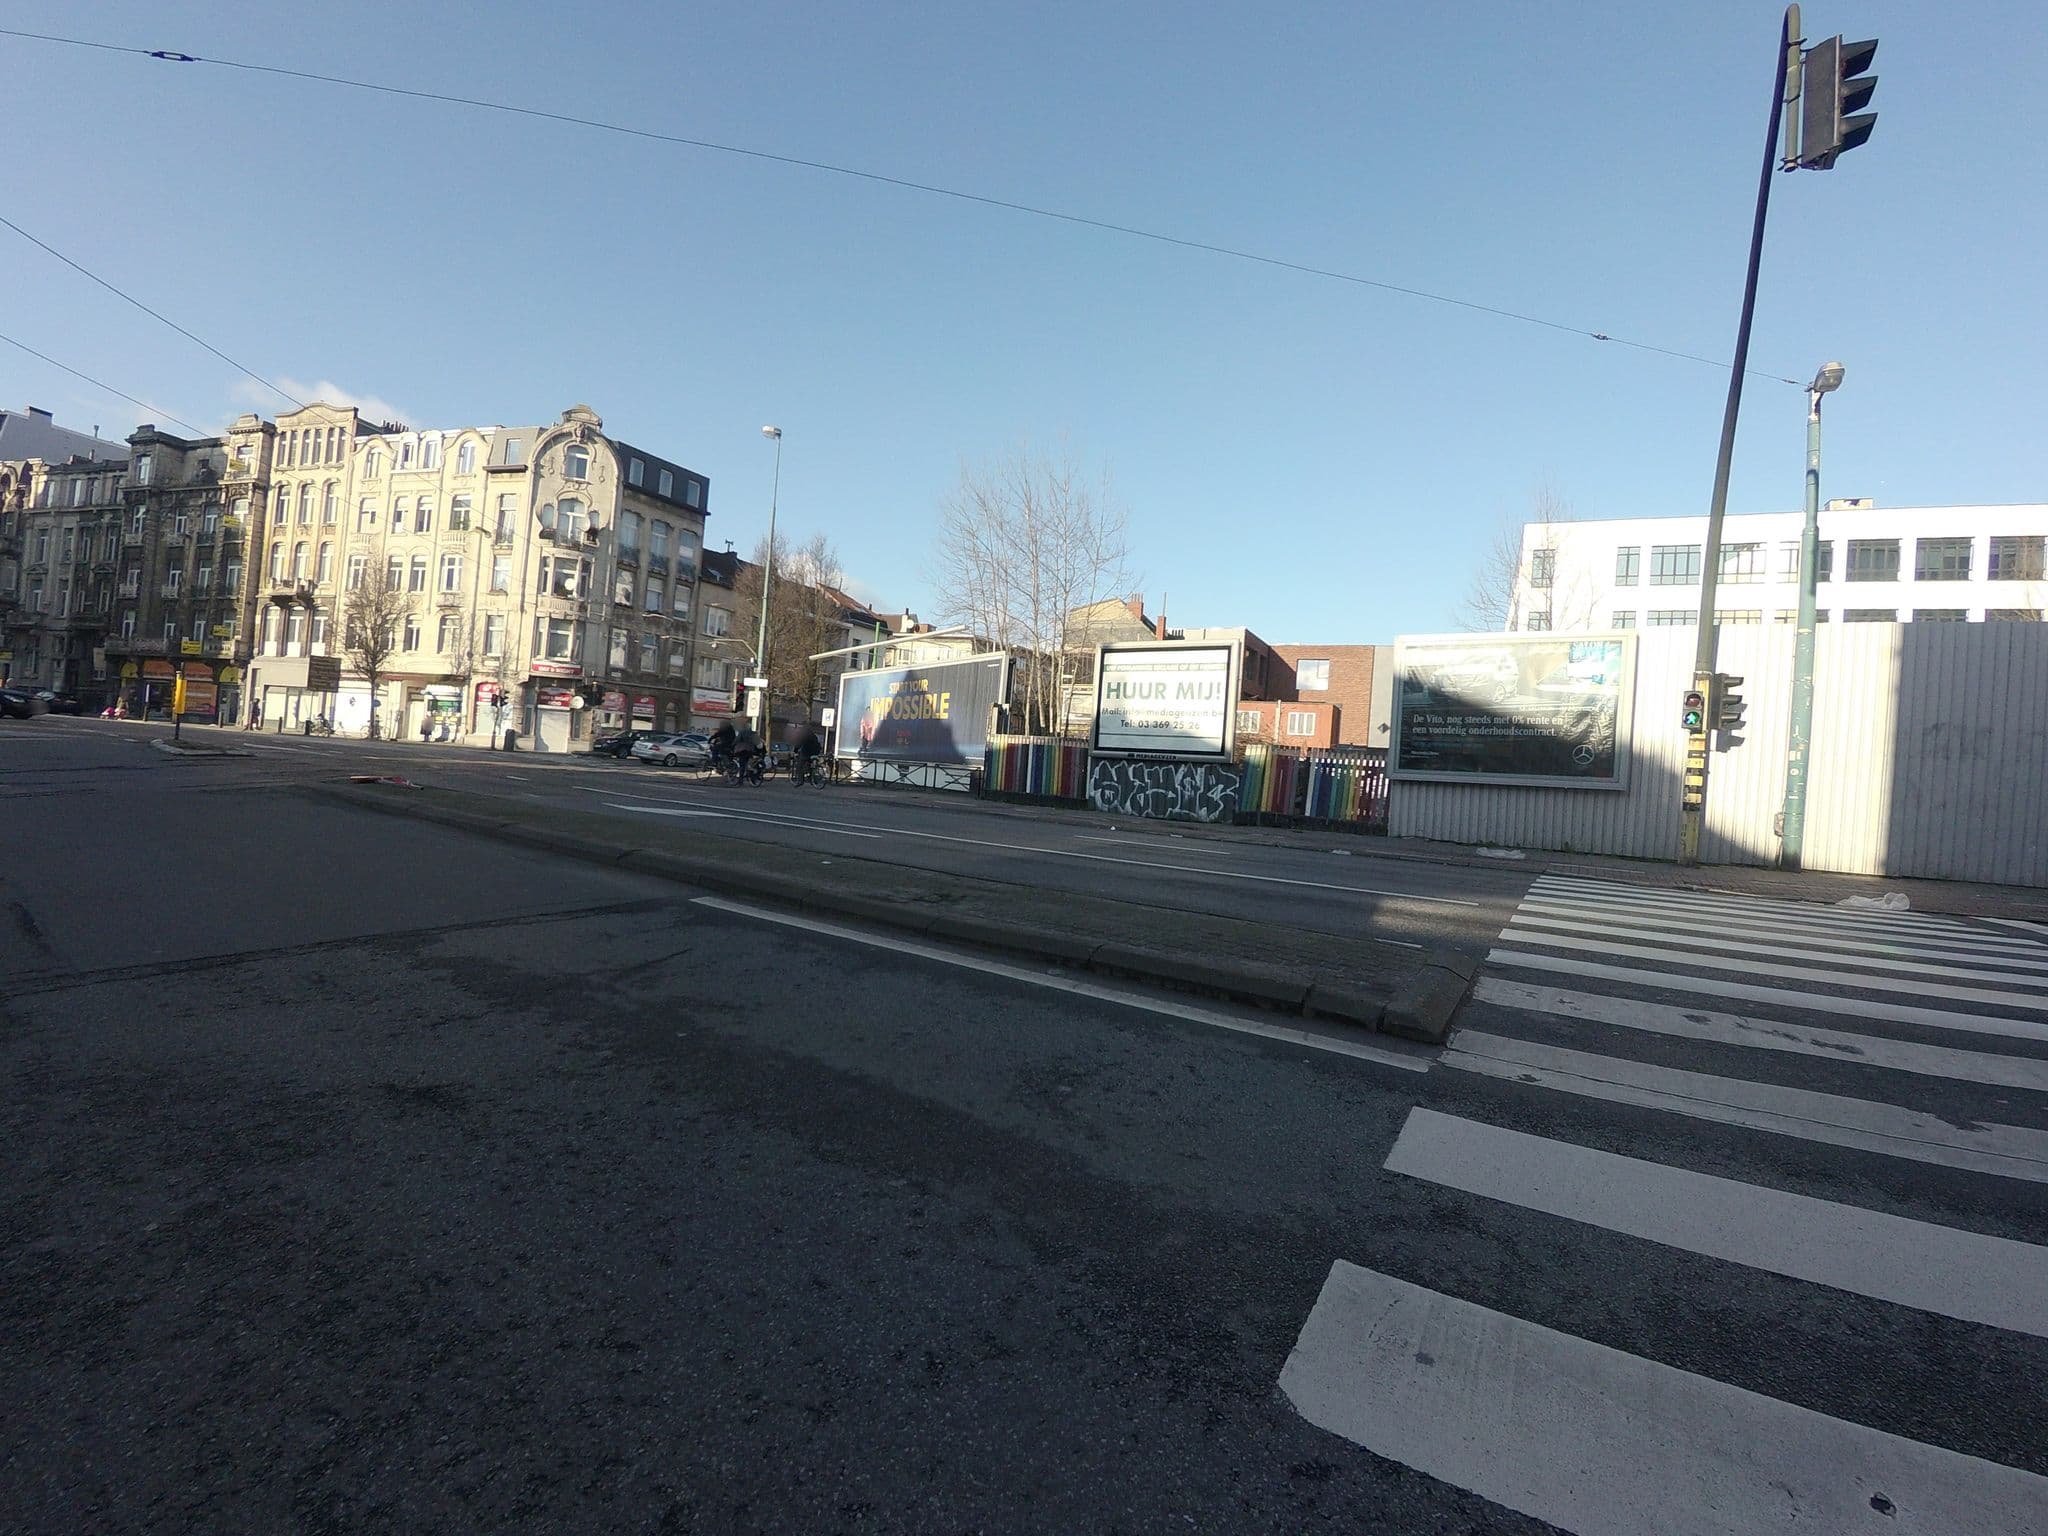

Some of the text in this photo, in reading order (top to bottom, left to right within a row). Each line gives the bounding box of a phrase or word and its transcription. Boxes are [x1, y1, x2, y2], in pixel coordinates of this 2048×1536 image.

[909, 679, 929, 692] YOUR
[1106, 681, 1221, 700] HUUR MIJ!
[870, 692, 951, 721] IMPOSSIBLE
[1101, 707, 1121, 716] Mail:
[1120, 719, 1136, 728] Tel:
[1138, 720, 1149, 729] 03
[1152, 720, 1170, 729] 369
[1413, 714, 1424, 723] De
[1426, 714, 1444, 725] Vito,
[1446, 716, 1463, 726] nog
[1463, 715, 1491, 724] steeds
[1493, 716, 1509, 724] met
[1511, 715, 1525, 724] 0%
[1526, 716, 1550, 725] rente
[1412, 726, 1558, 737] een voordelig onderhoudscontract.
